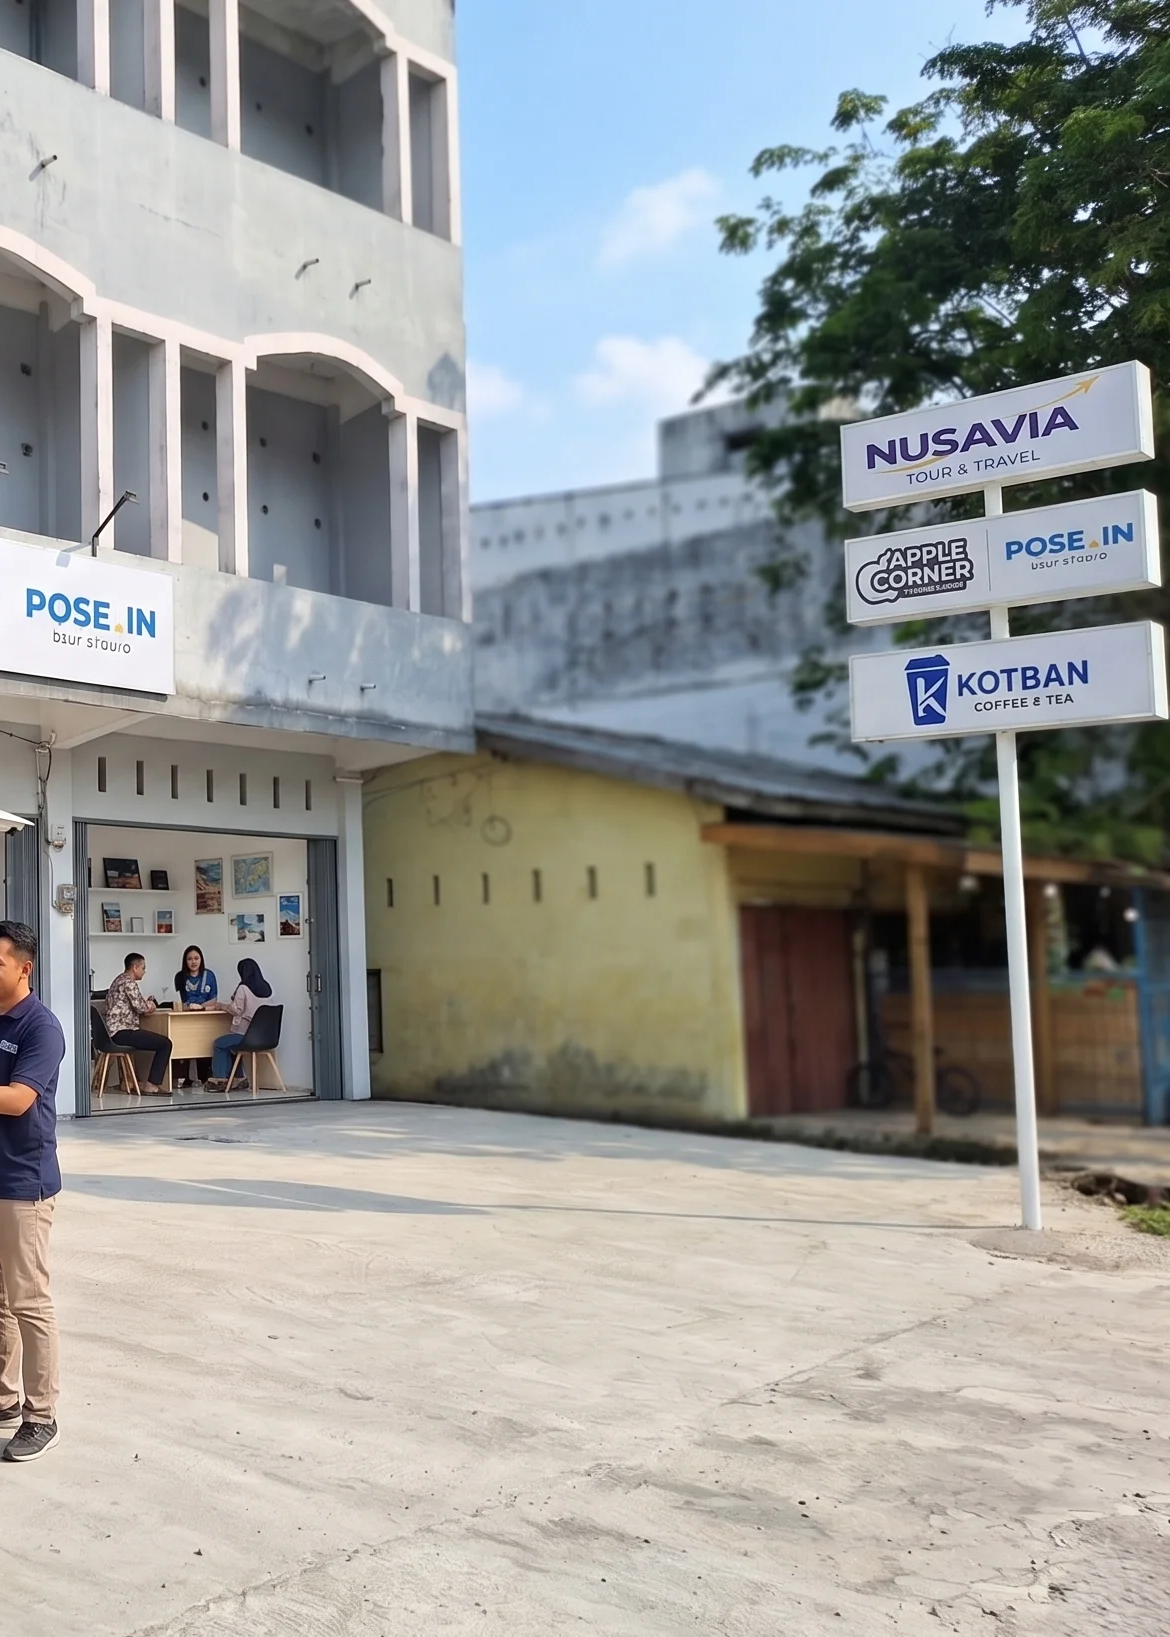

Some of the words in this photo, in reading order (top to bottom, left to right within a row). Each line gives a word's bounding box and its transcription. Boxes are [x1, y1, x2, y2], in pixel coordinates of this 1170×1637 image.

[866, 406, 1080, 469] NUSAVIA
[906, 466, 952, 485] TOUR
[957, 463, 969, 475] &
[973, 449, 1041, 472] TRAVEL
[889, 541, 965, 569] APPLE
[873, 561, 971, 590] CORNER
[957, 660, 1089, 697] KOTBAN
[974, 698, 1029, 712] COFFEE
[1046, 694, 1074, 705] TEA
